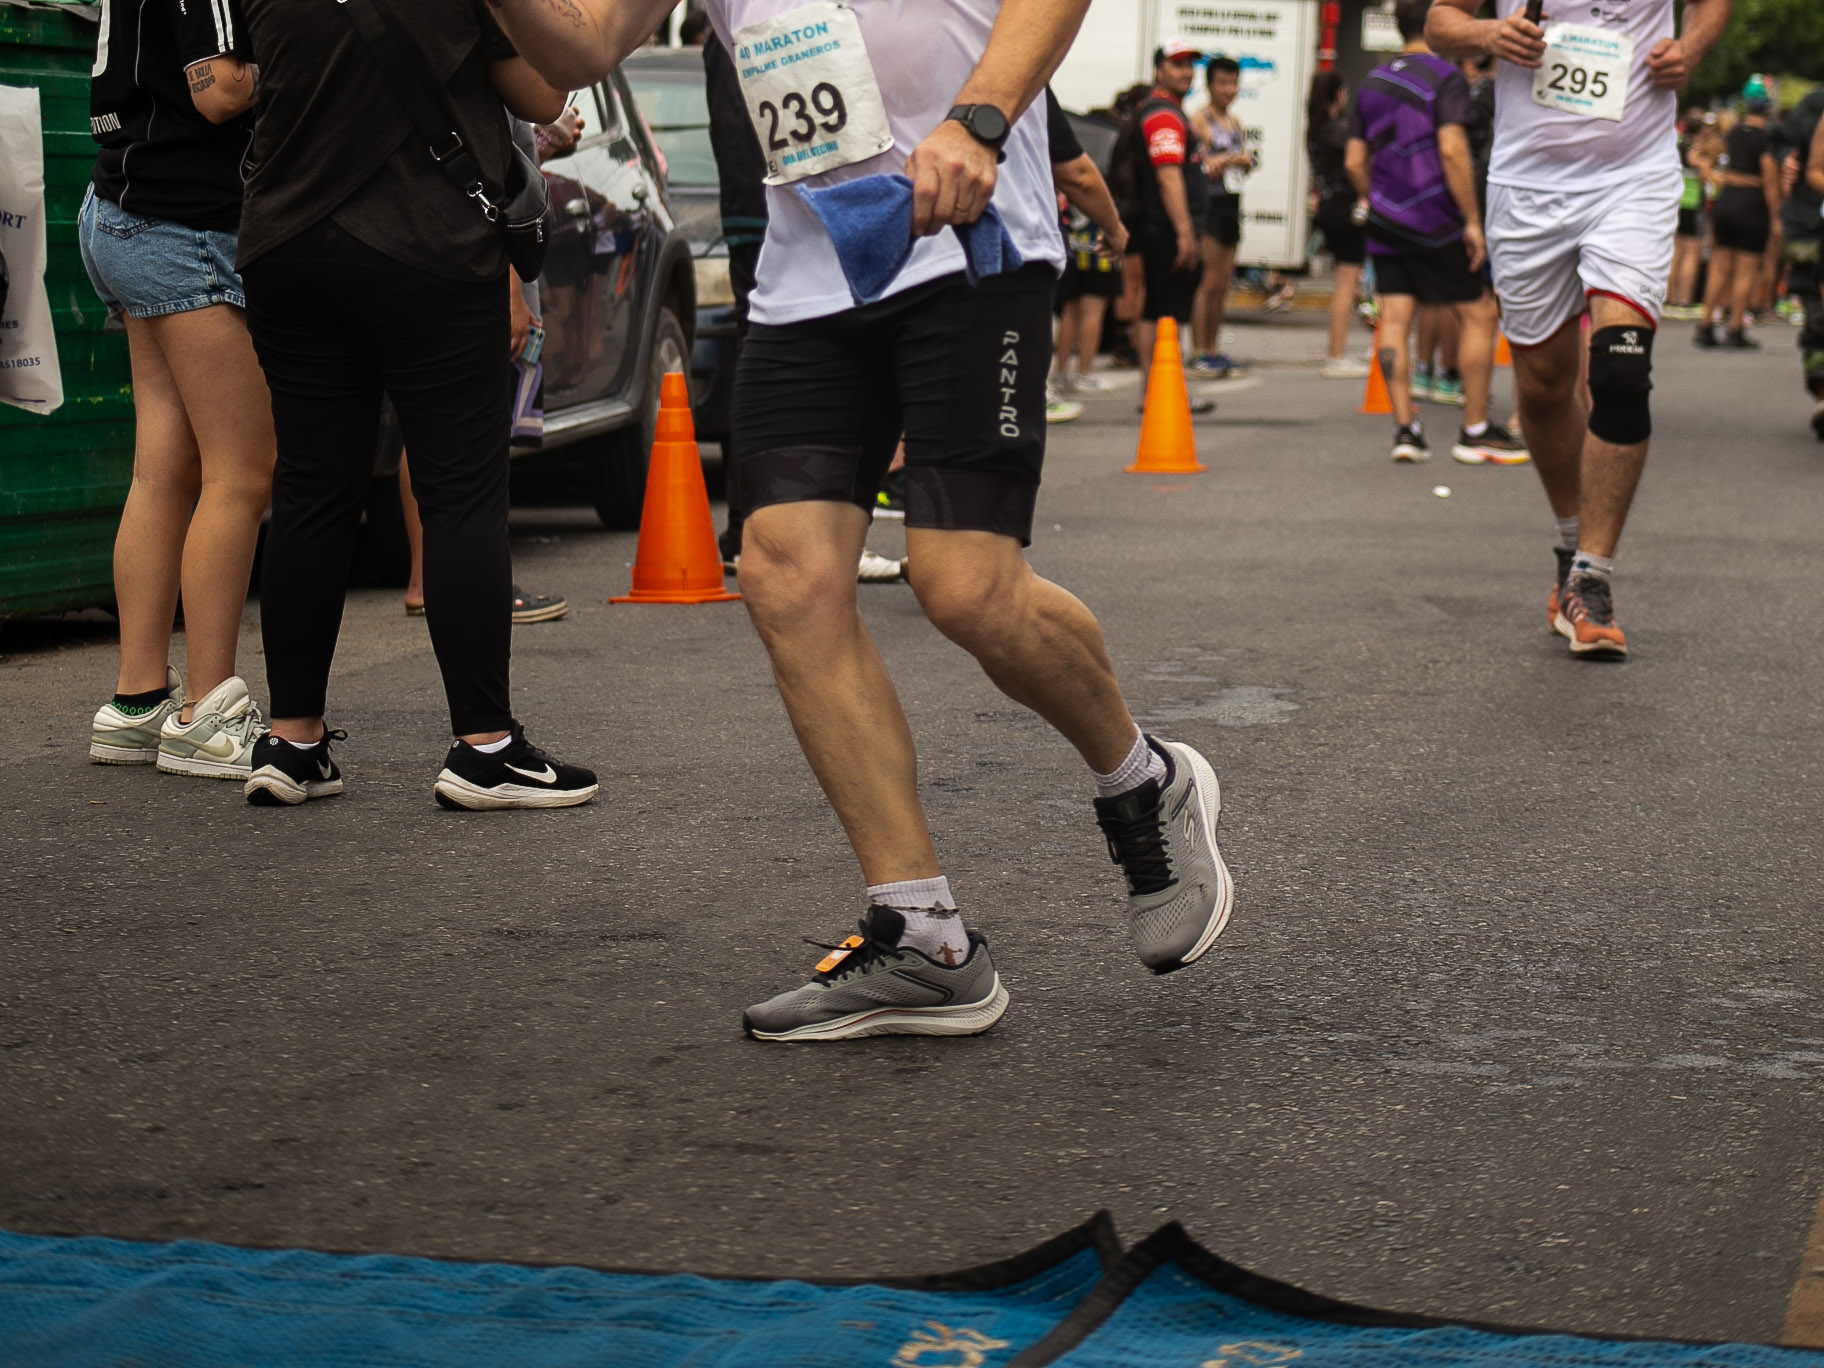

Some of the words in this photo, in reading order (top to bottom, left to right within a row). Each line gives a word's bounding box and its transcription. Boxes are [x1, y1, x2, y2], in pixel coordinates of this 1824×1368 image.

[739, 47, 751, 60] 40
[753, 21, 829, 57] MARATON
[742, 60, 778, 79] EMPALME
[781, 40, 841, 66] GRANEROS
[1547, 63, 1609, 98] 295
[759, 82, 848, 152] 239
[0, 210, 27, 229] RT
[1000, 331, 1020, 438] PANTRO
